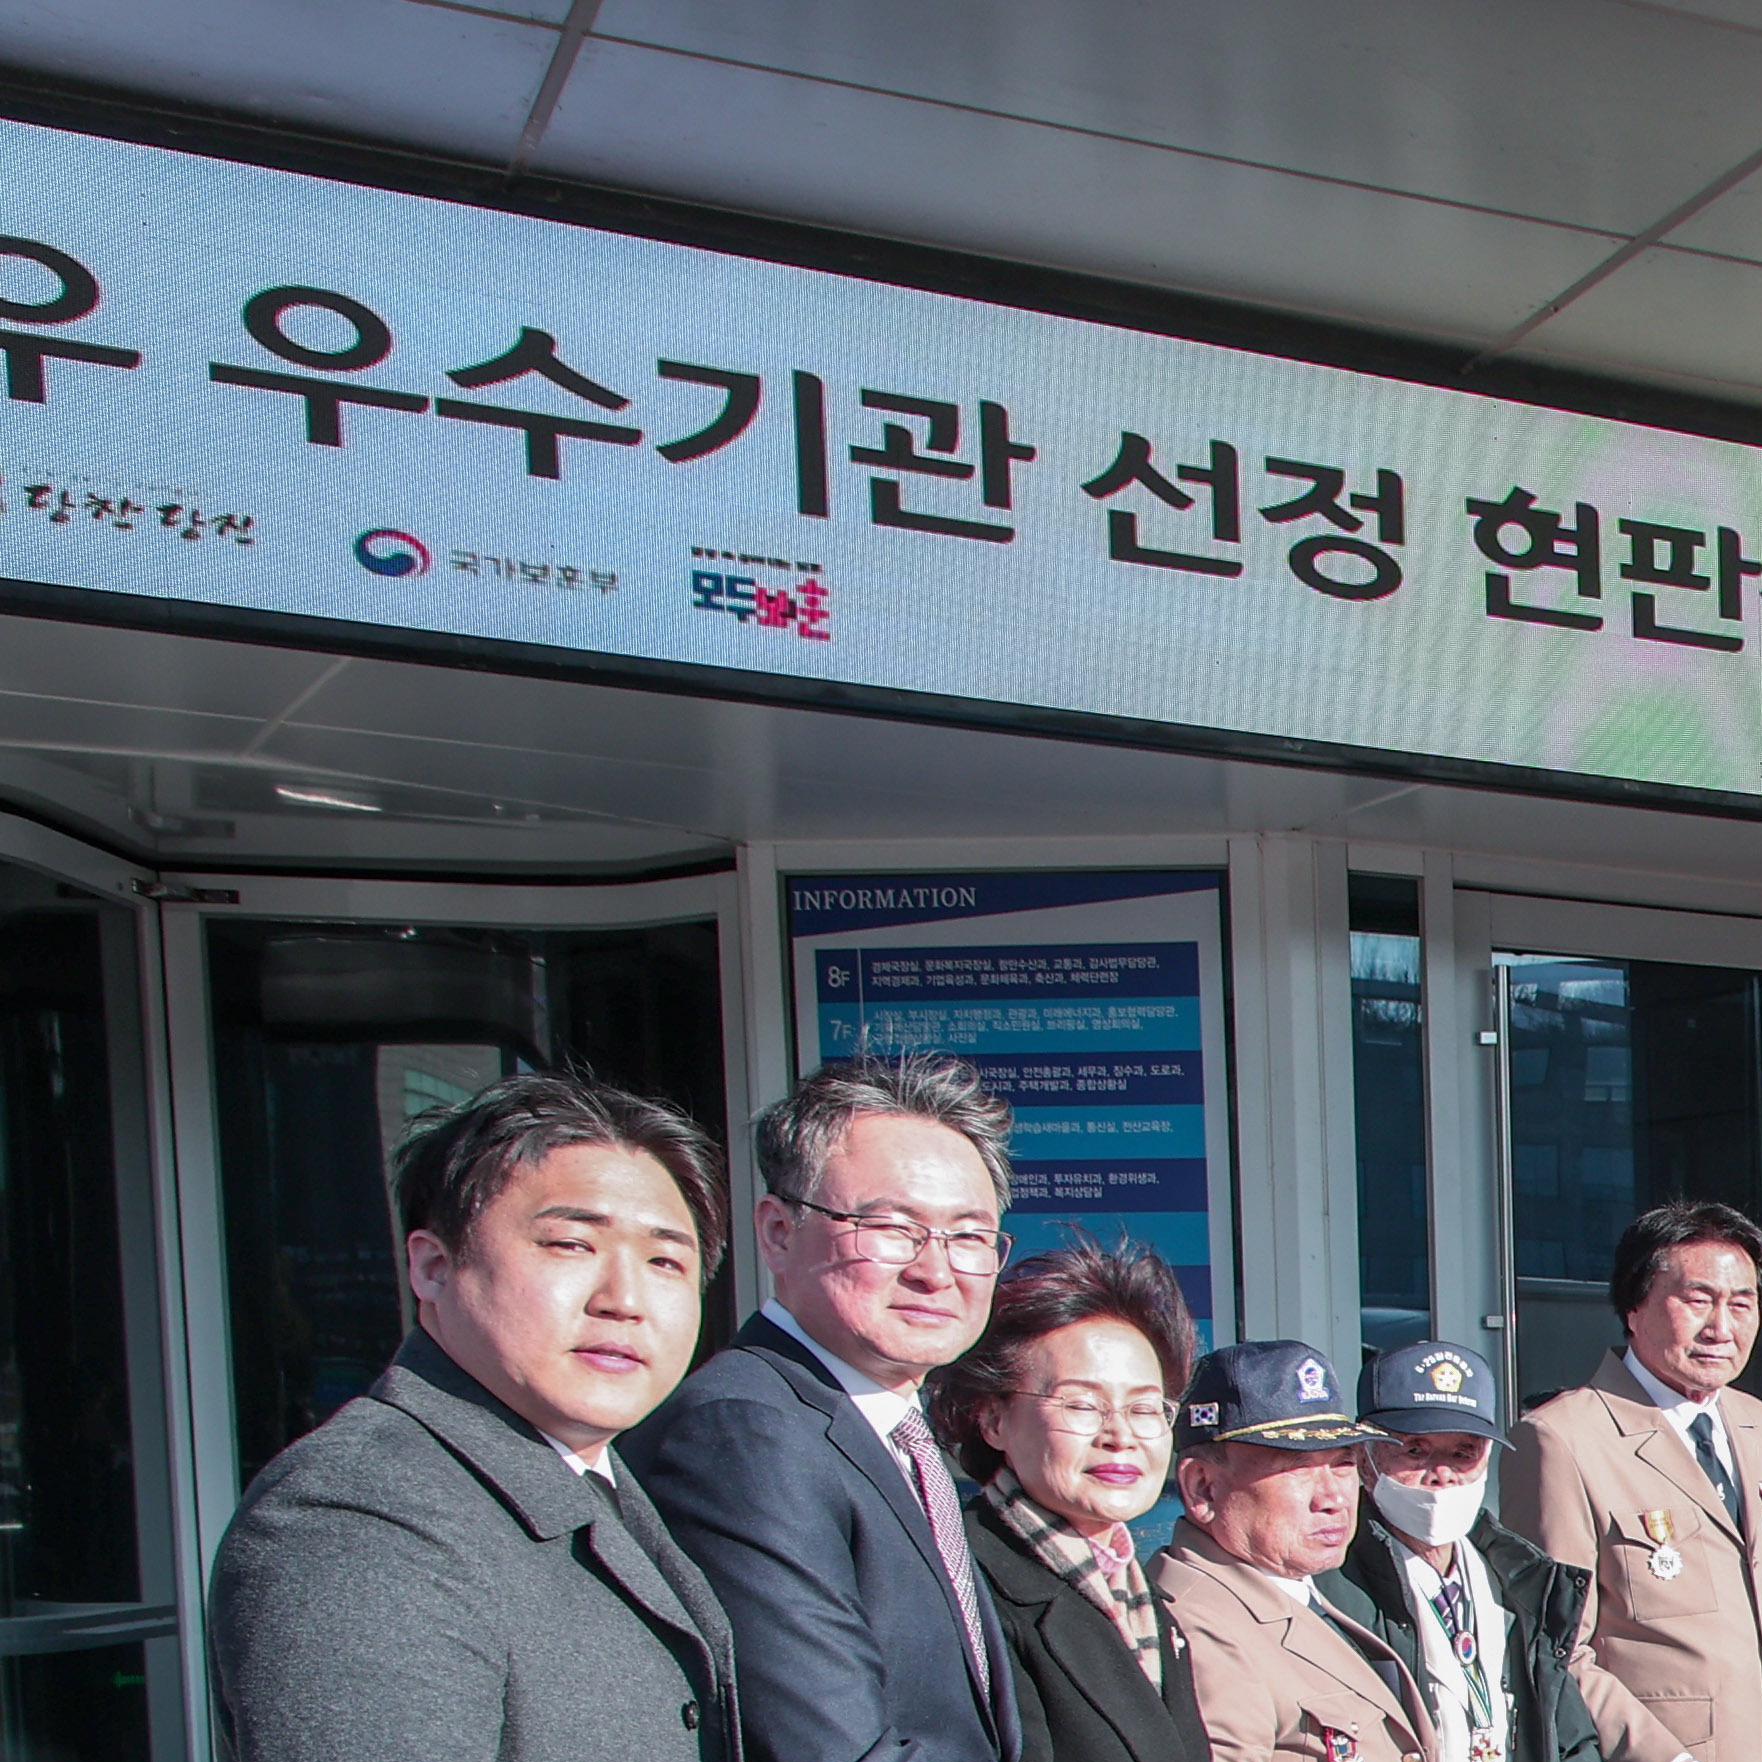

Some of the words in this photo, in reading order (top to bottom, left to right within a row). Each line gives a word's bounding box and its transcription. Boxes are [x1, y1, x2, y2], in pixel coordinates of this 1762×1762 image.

[208, 283, 1037, 545] 우수기관
[1079, 429, 1405, 603] 선정
[449, 548, 621, 595] 국가보훈부
[793, 886, 977, 912] INFORMATION
[827, 966, 851, 988] 8F
[829, 1020, 852, 1041] 7F
[1150, 1063, 1185, 1076] 도로과,
